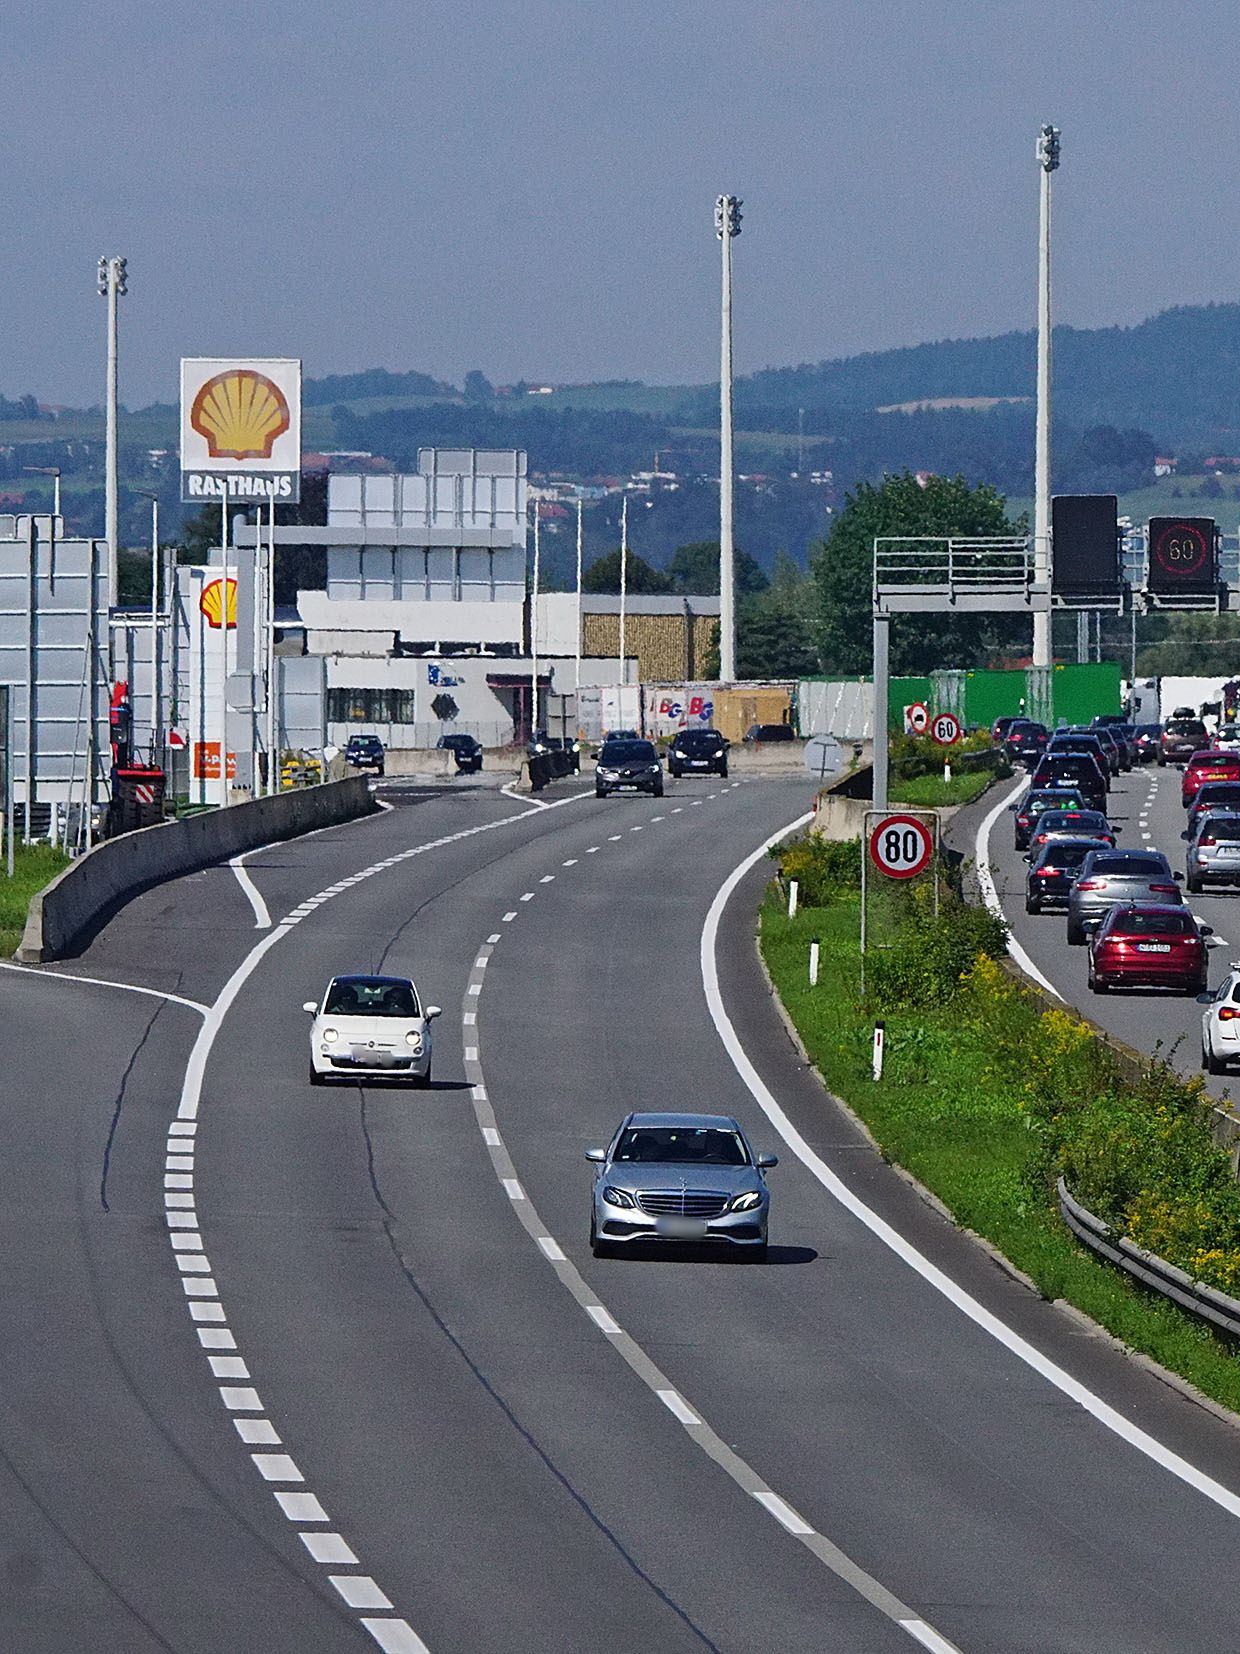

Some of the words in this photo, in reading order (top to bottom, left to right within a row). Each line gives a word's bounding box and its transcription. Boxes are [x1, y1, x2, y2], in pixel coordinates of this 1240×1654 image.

[1169, 539, 1194, 560] 60
[937, 721, 954, 739] 60
[885, 829, 918, 864] 80
